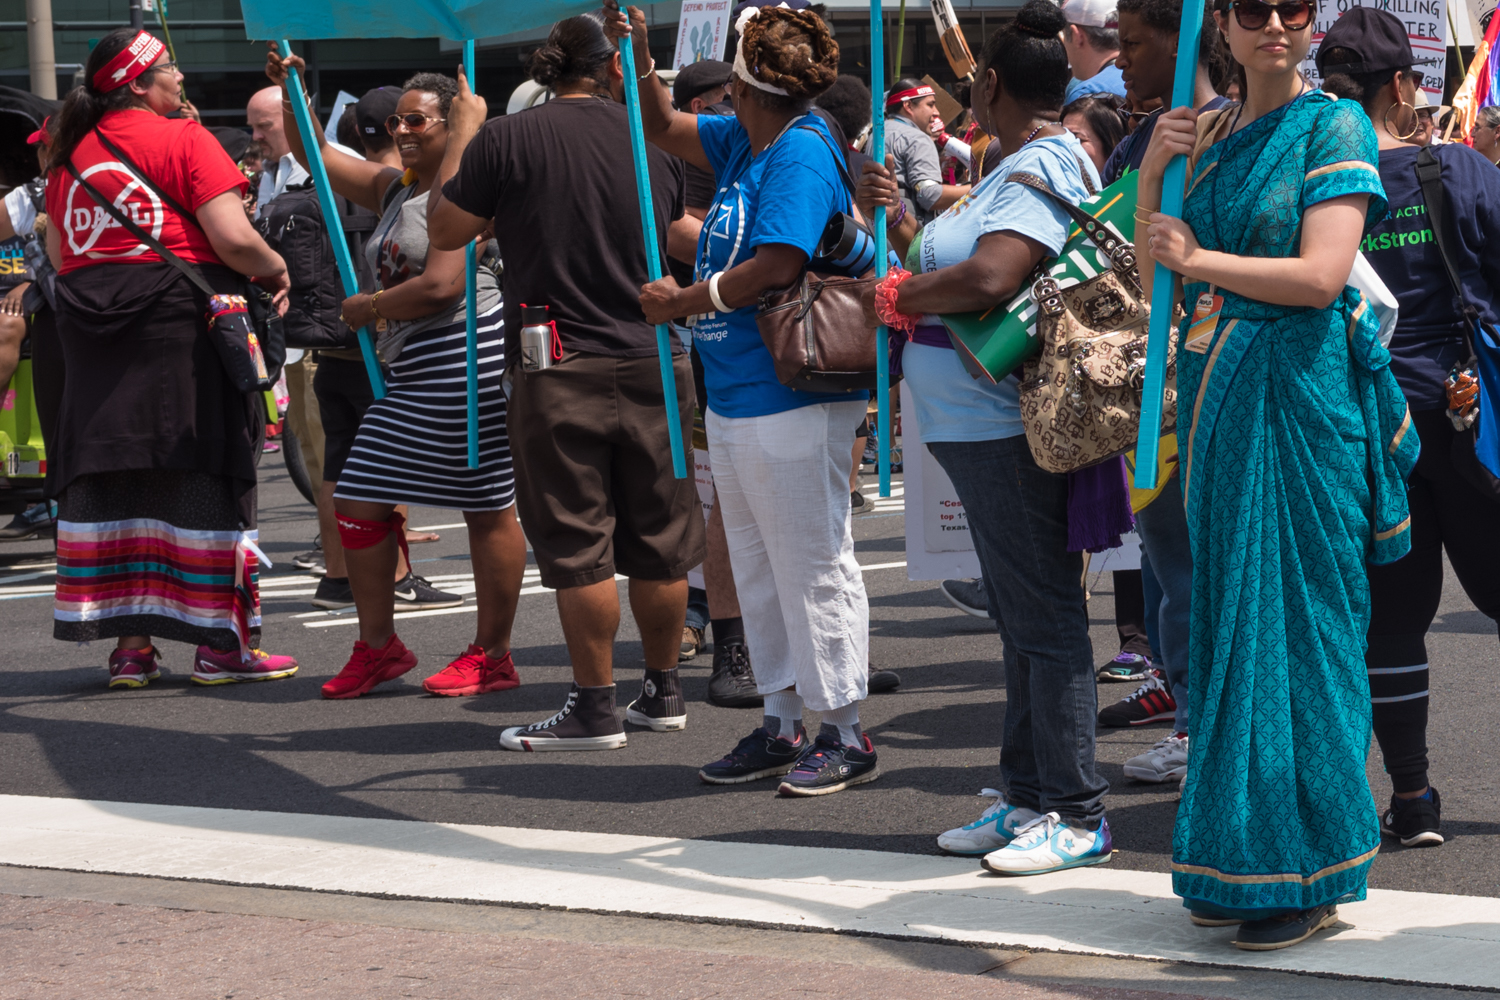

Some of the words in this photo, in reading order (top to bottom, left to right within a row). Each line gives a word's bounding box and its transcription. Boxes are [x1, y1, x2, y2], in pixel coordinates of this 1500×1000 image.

[684, 2, 704, 13] DEFEND
[705, 0, 727, 11] PROTECT
[1395, 204, 1428, 218] ACTI
[940, 512, 955, 522] top
[940, 523, 970, 533] Texas.
